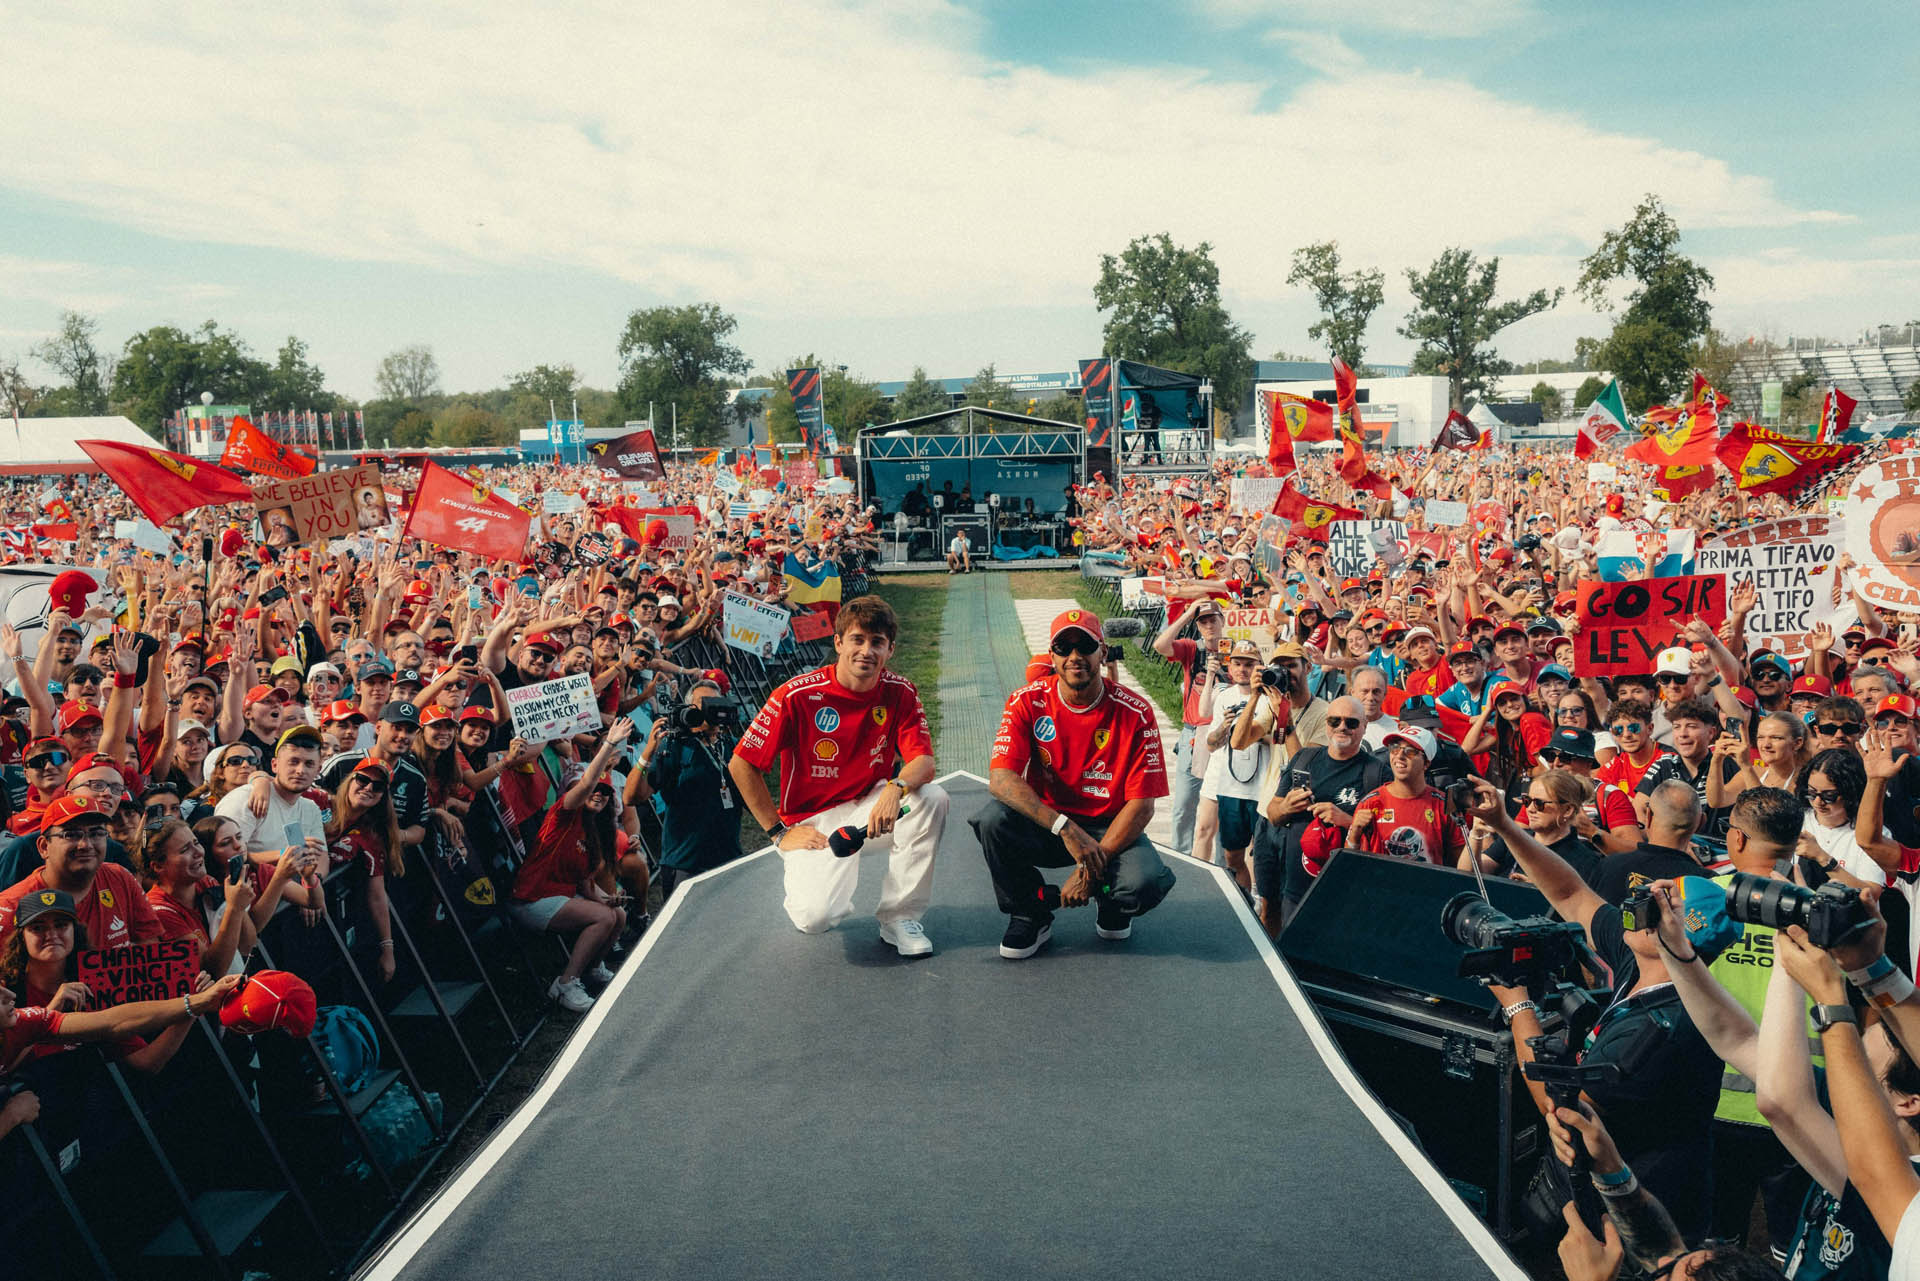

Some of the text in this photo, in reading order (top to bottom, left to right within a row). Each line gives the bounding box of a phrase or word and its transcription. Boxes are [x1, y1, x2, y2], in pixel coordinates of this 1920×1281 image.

[253, 470, 371, 502] WE BELIEVE
[311, 496, 335, 515] IN
[440, 497, 511, 520] LEWIS HAMILTON
[304, 510, 350, 538] YOU
[455, 516, 489, 534] 44
[1331, 521, 1364, 539] ALL
[1723, 517, 1830, 548] HERE
[580, 536, 609, 558] LEC
[1329, 539, 1366, 558] THE
[1700, 543, 1835, 569] PRIMA TIFAVO
[1587, 577, 1717, 619] GO SIR
[1773, 589, 1814, 611] TIFO
[787, 671, 826, 690] Ferrari
[508, 686, 542, 703] CHARLES
[1115, 688, 1149, 712] Ferrari
[818, 709, 836, 732] hp
[1036, 720, 1053, 741] hp
[811, 765, 839, 778] IBM
[1083, 771, 1113, 781] UniCredit
[1726, 952, 1774, 968] GRO
[107, 962, 172, 987] VINCI
